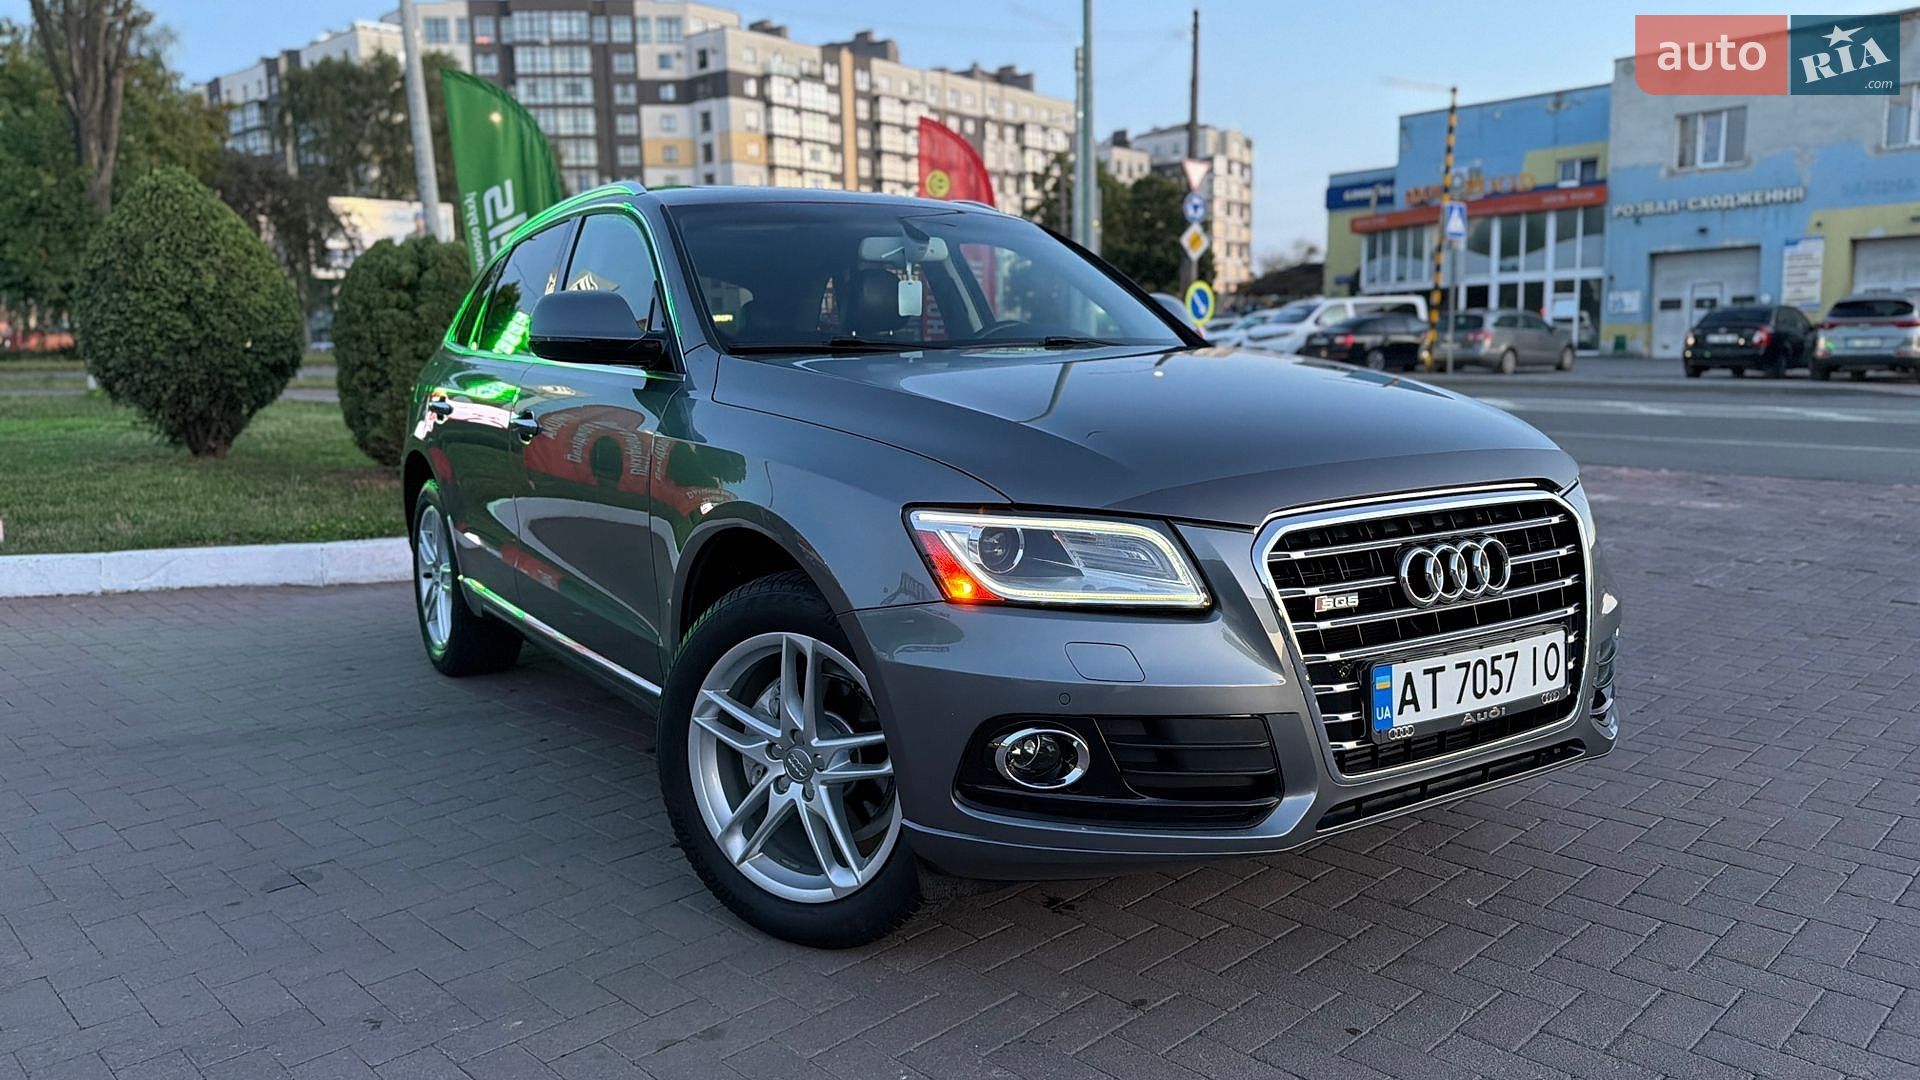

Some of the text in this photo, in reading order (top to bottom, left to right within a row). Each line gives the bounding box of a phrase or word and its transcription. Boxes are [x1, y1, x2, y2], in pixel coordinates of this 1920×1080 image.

[1397, 641, 1560, 716] AT 7057 IO
[1375, 705, 1392, 721] UA
[1460, 707, 1507, 726] Audi
